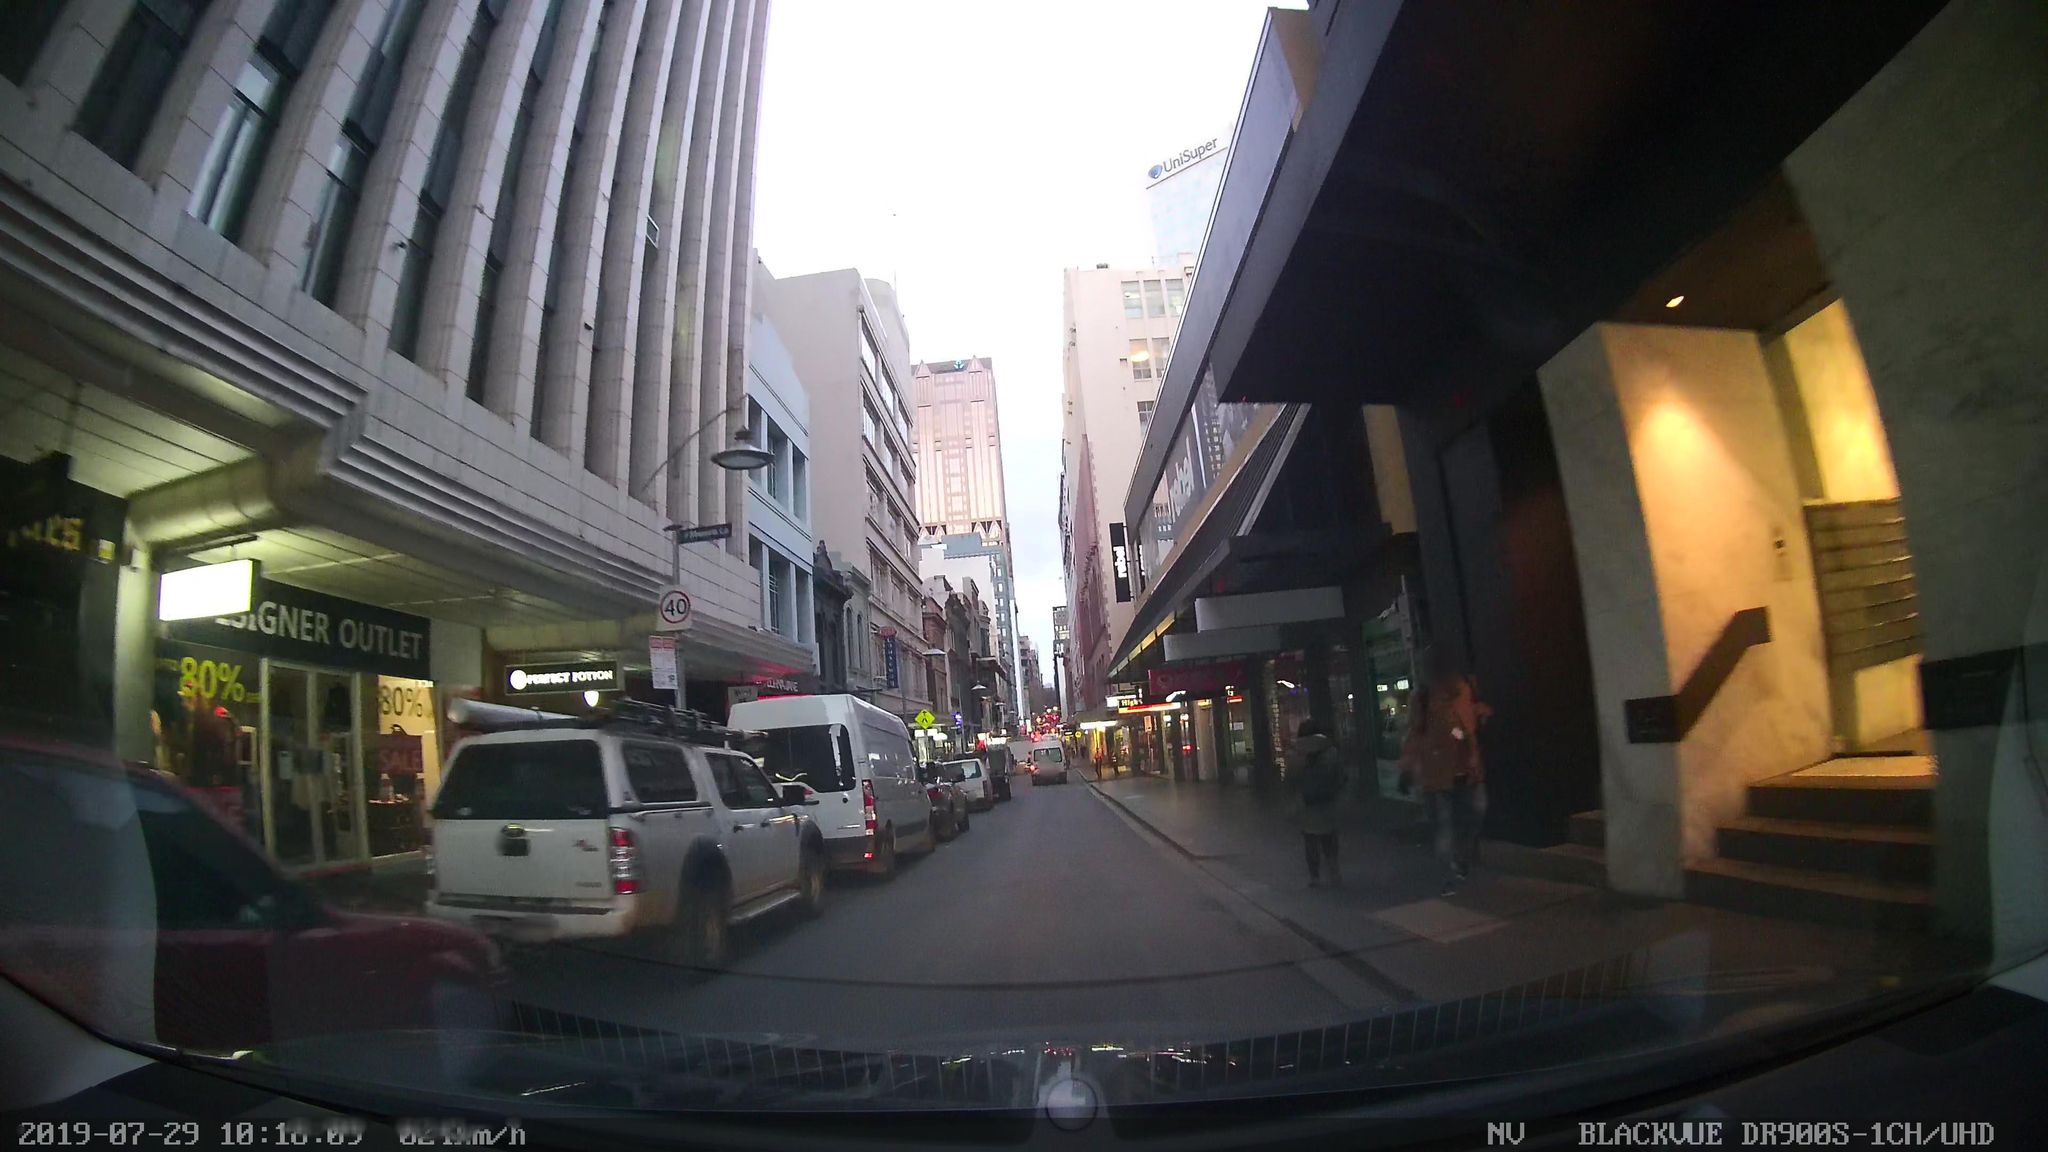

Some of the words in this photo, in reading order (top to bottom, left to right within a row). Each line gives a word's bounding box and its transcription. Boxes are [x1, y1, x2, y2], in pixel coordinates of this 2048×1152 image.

[1162, 138, 1217, 172] UniSuper
[664, 598, 687, 617] 40
[338, 618, 423, 660] OUTLET
[179, 656, 246, 702] 80%
